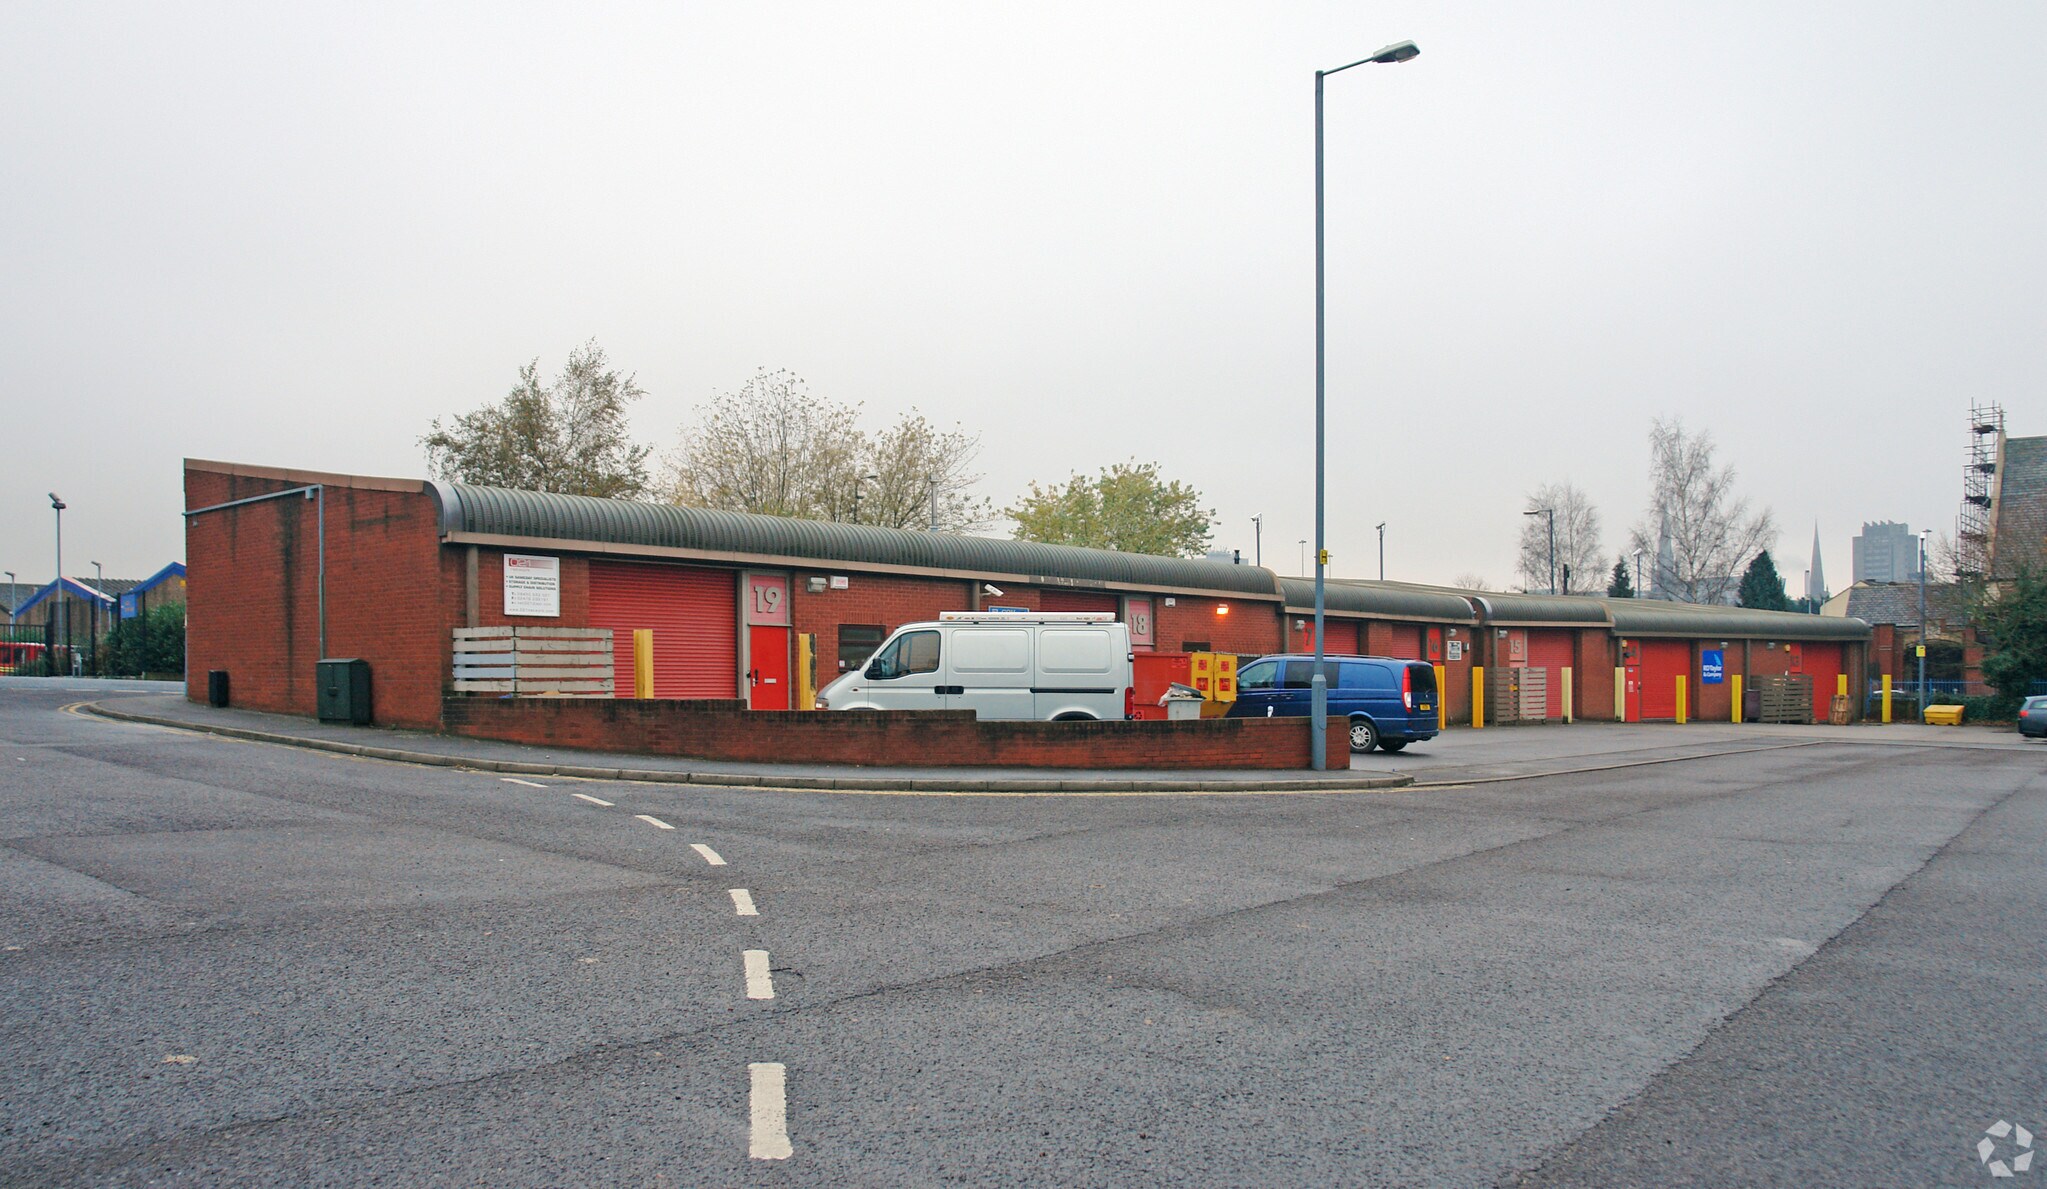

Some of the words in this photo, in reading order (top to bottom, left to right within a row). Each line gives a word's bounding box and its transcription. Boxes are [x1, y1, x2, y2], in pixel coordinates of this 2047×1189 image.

[754, 586, 782, 613] 19
[1130, 614, 1148, 635] 18
[1510, 640, 1520, 654] 15
